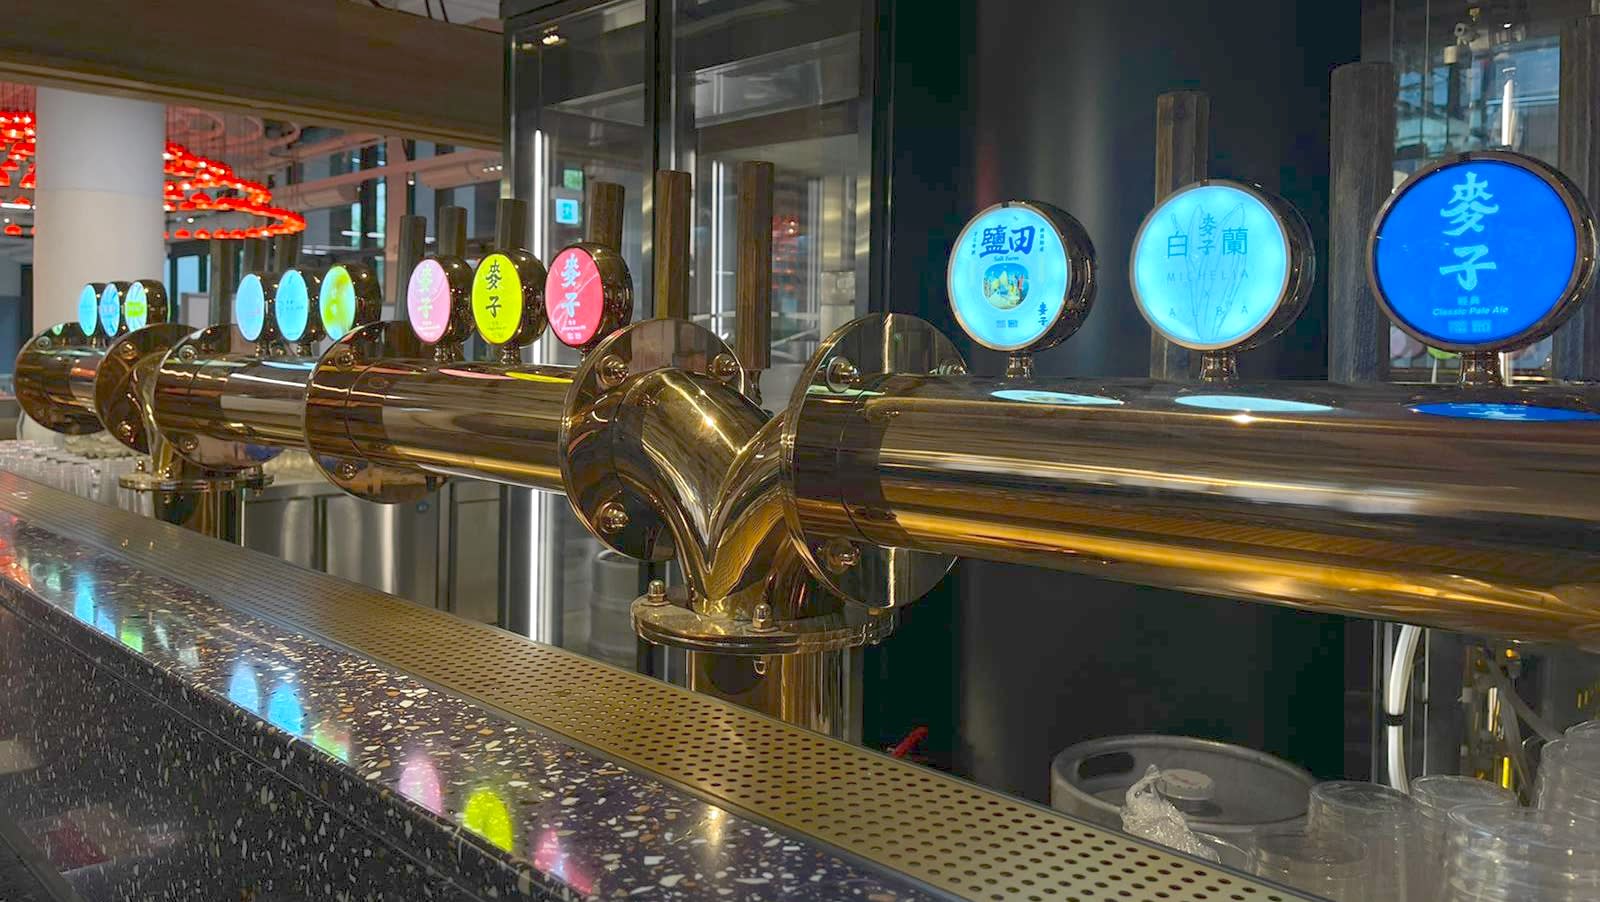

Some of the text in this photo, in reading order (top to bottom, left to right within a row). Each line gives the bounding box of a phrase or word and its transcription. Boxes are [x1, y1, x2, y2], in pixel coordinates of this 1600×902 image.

[979, 224, 1036, 258] 鹽田
[1198, 213, 1217, 256] 麥子
[1440, 171, 1499, 291] 麥子
[485, 259, 502, 318] 麥子
[561, 252, 582, 318] 麥子
[1166, 269, 1249, 282] MICHELIA
[1432, 305, 1509, 317] Classic Pale Ale
